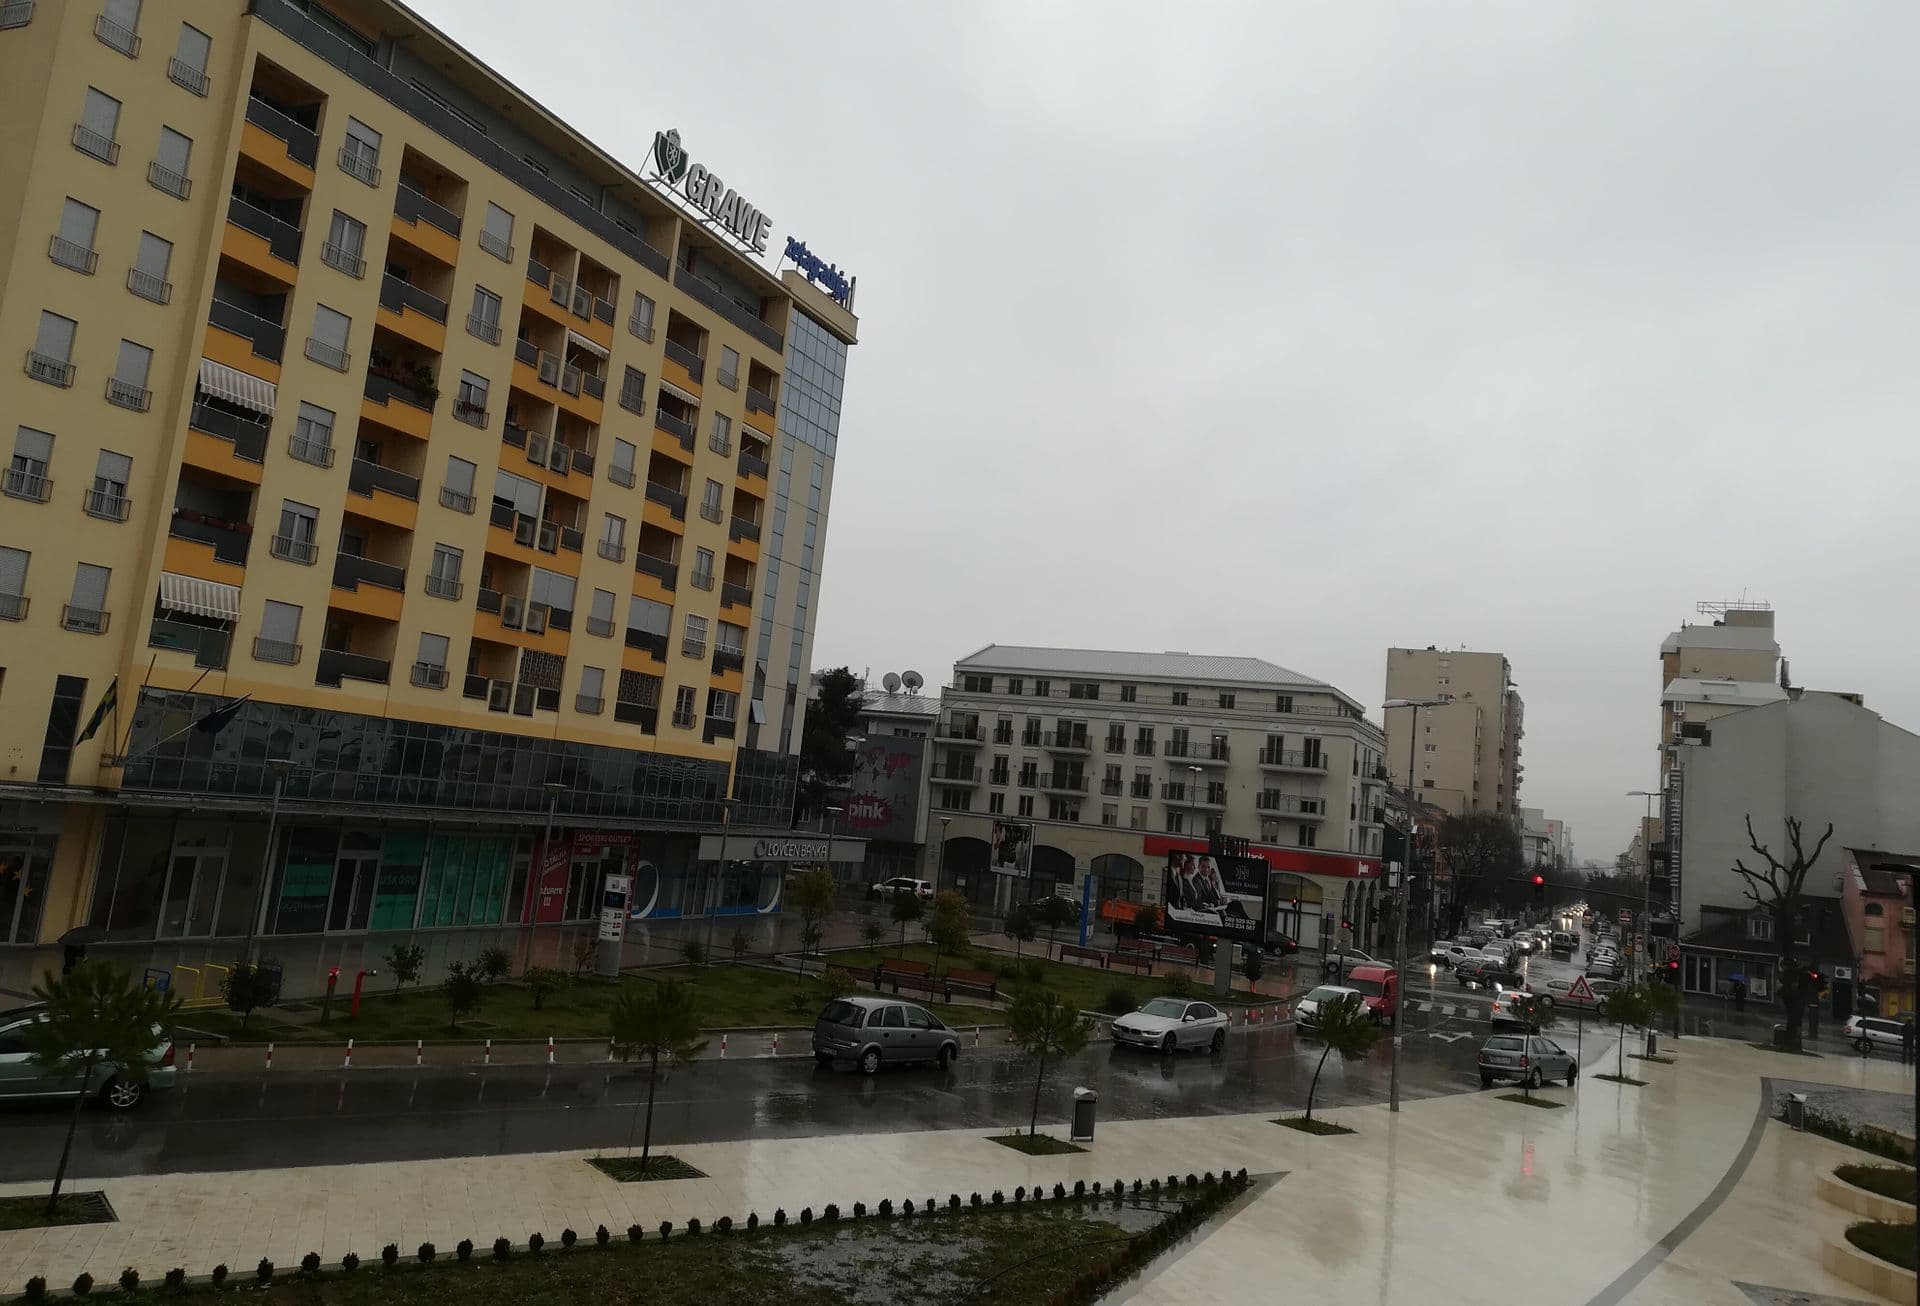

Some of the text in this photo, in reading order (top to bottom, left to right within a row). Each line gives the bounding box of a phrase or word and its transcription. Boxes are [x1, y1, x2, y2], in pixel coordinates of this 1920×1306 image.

[685, 163, 773, 252] GRAWE
[848, 799, 885, 821] pink
[801, 843, 828, 858] BANKA
